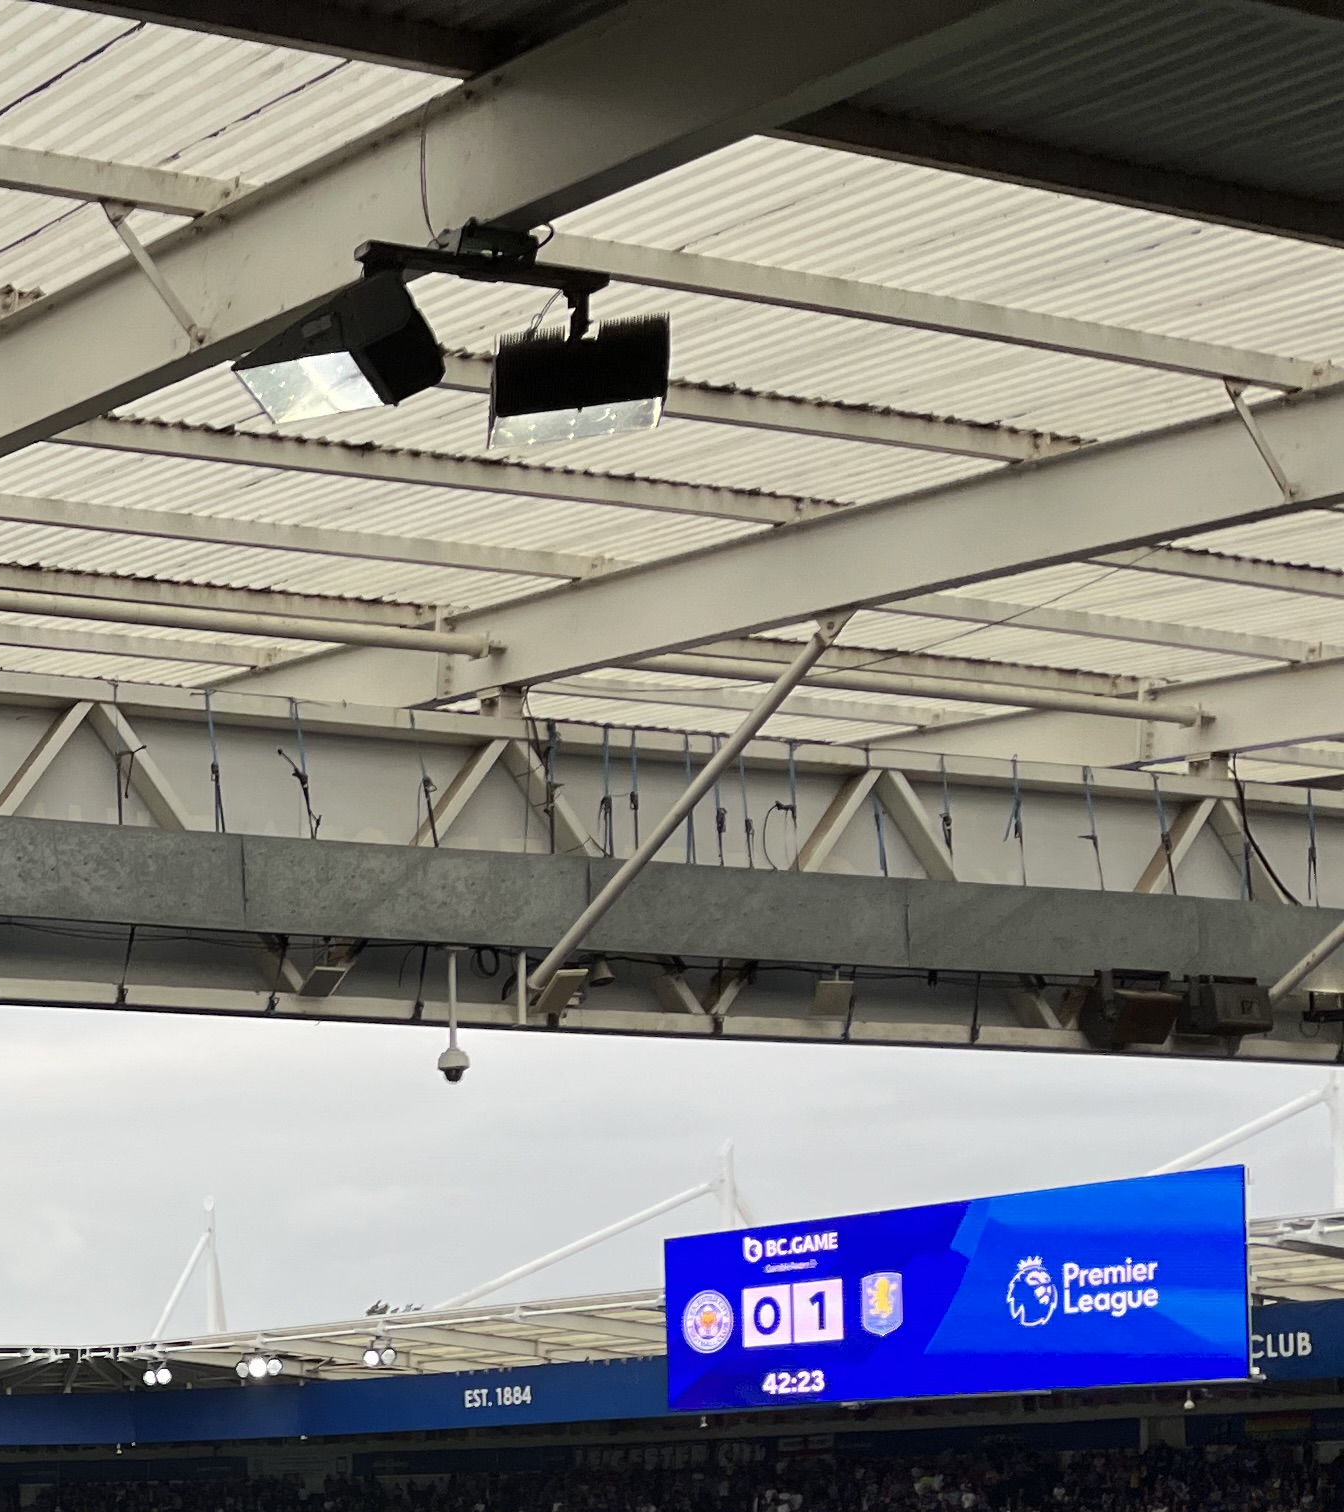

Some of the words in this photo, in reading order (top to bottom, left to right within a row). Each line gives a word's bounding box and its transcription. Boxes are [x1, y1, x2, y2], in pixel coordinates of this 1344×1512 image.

[765, 1232, 839, 1257] BC.GAME
[1064, 1257, 1158, 1288] Premier
[754, 1296, 781, 1335] 0
[809, 1291, 826, 1330] 1
[1064, 1287, 1158, 1317] League
[464, 1389, 492, 1408] EST.
[496, 1386, 531, 1406] 1884
[763, 1370, 825, 1395] 42:23
